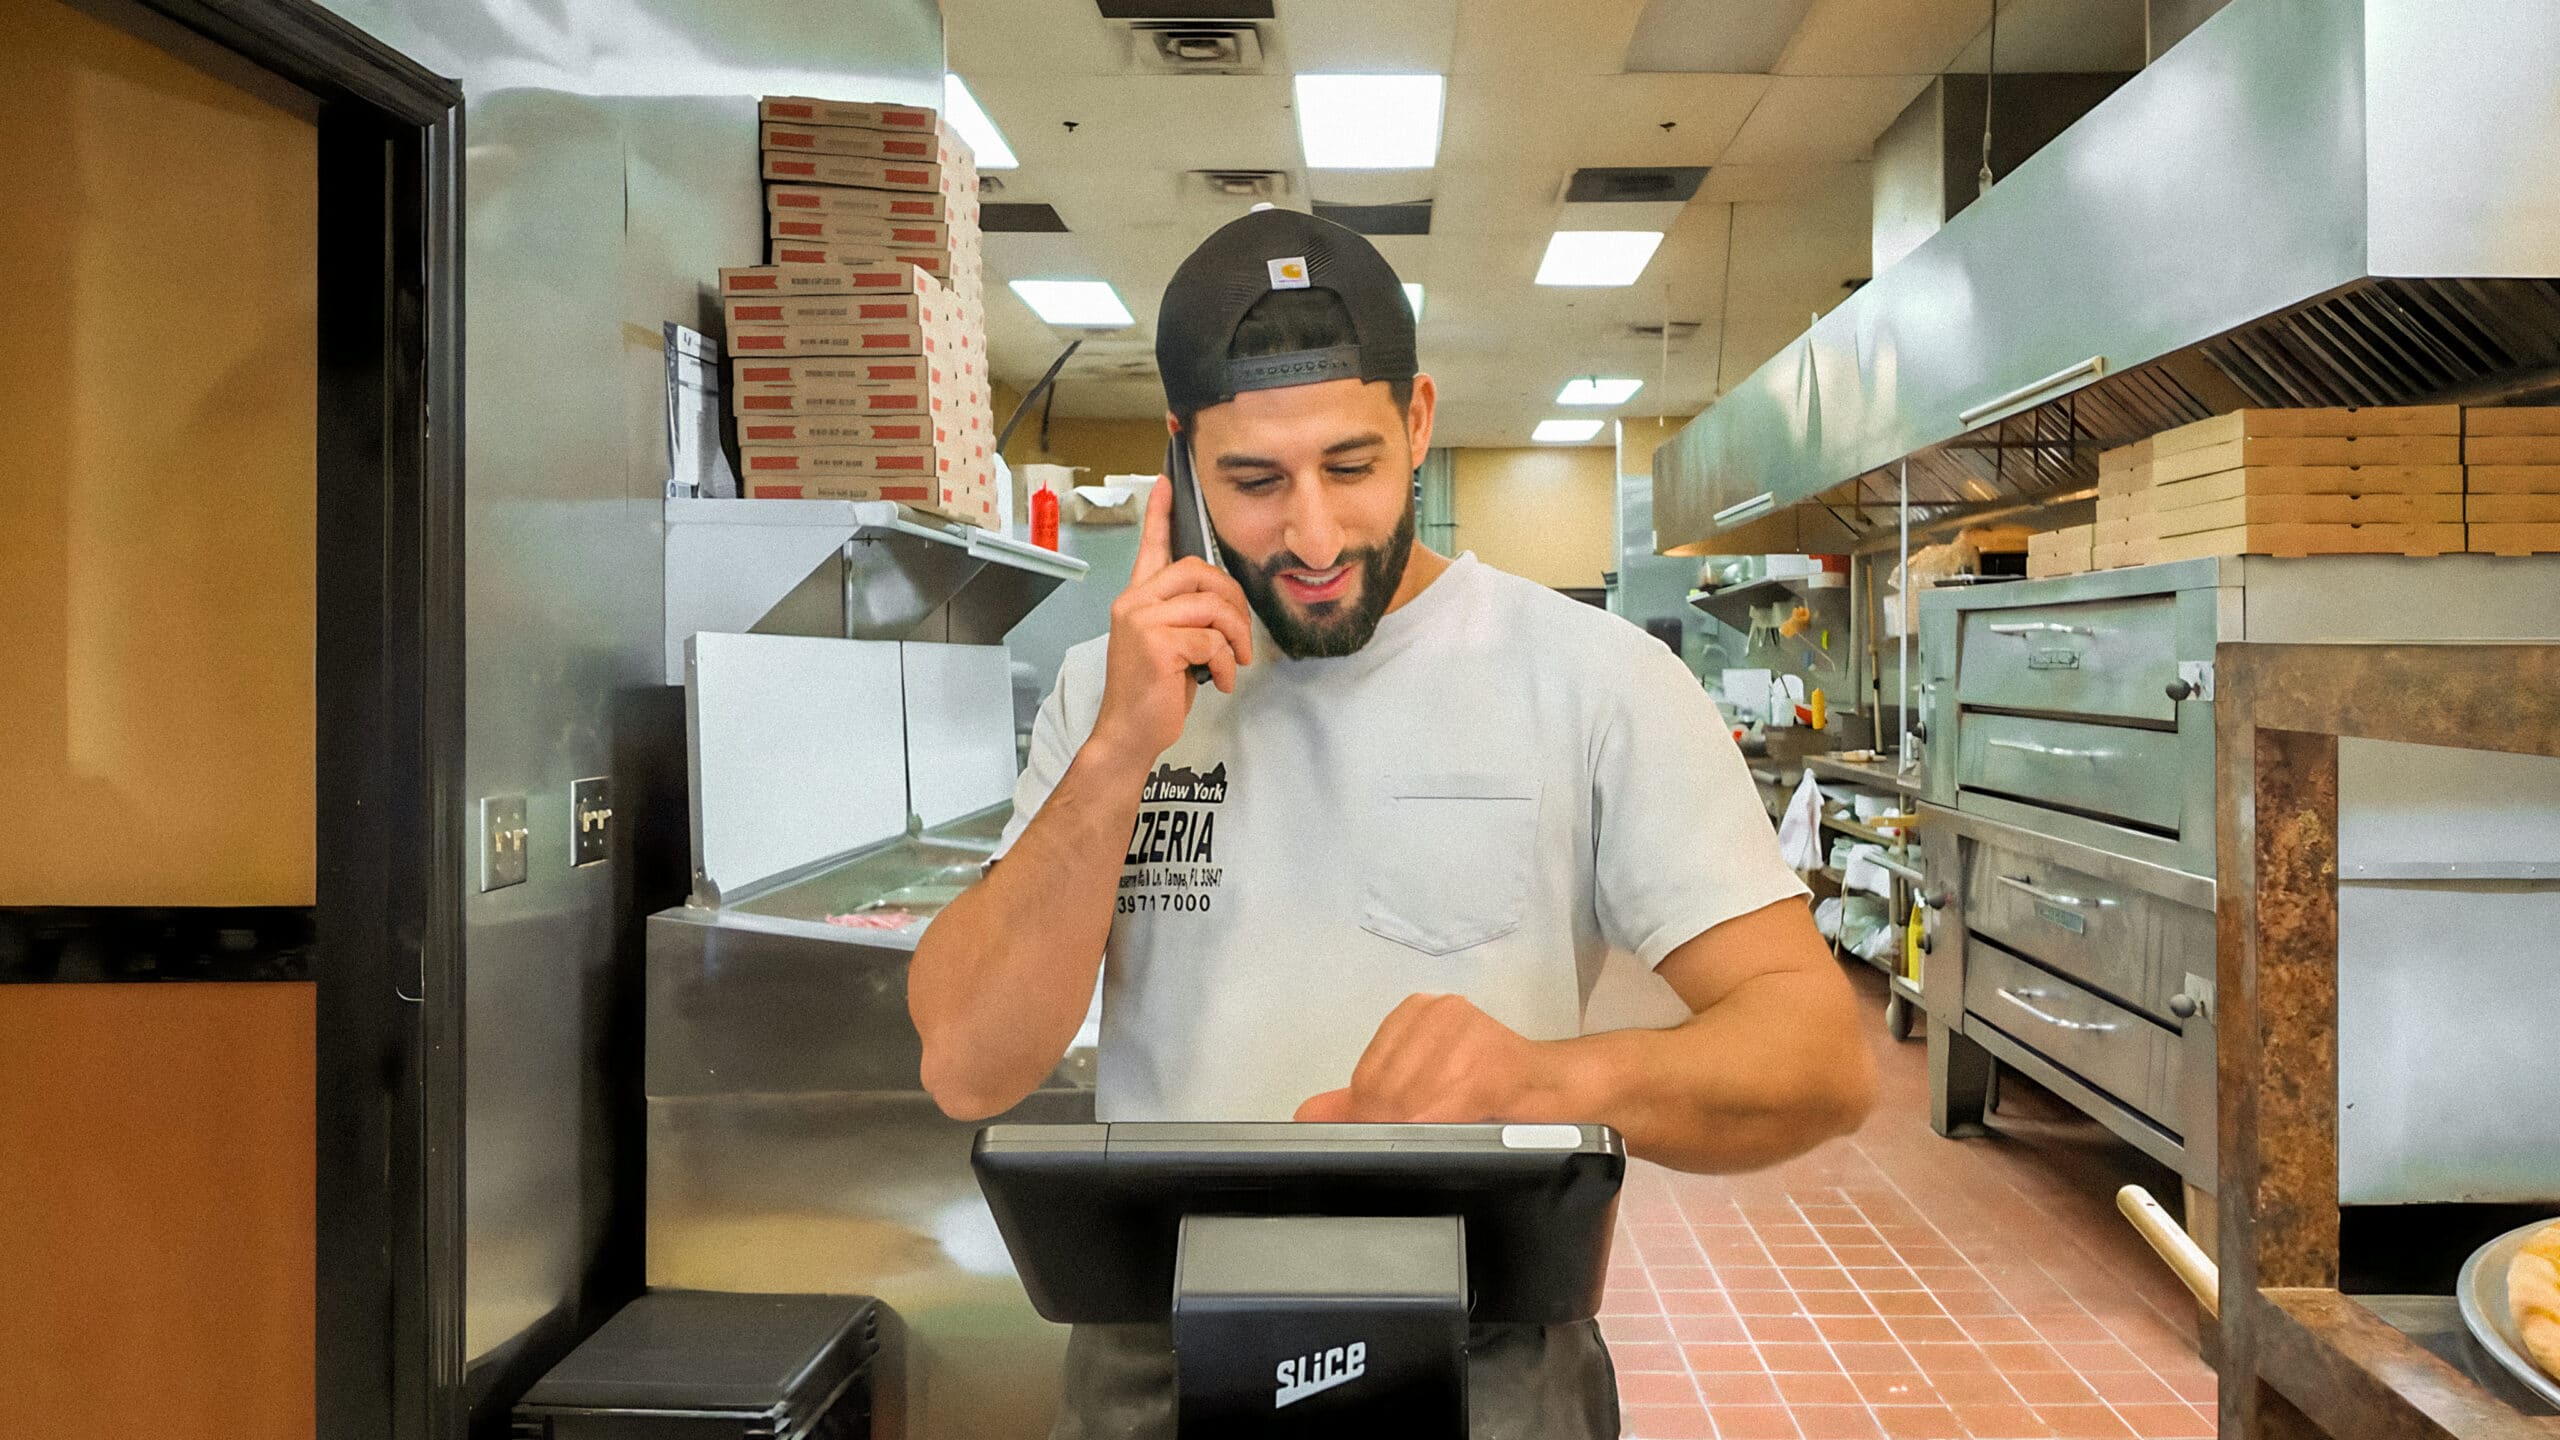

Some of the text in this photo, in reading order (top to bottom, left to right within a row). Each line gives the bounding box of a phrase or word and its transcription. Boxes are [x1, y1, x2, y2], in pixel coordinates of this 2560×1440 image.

[1143, 781, 1224, 801] of New York
[1118, 894, 1210, 914] 39717000
